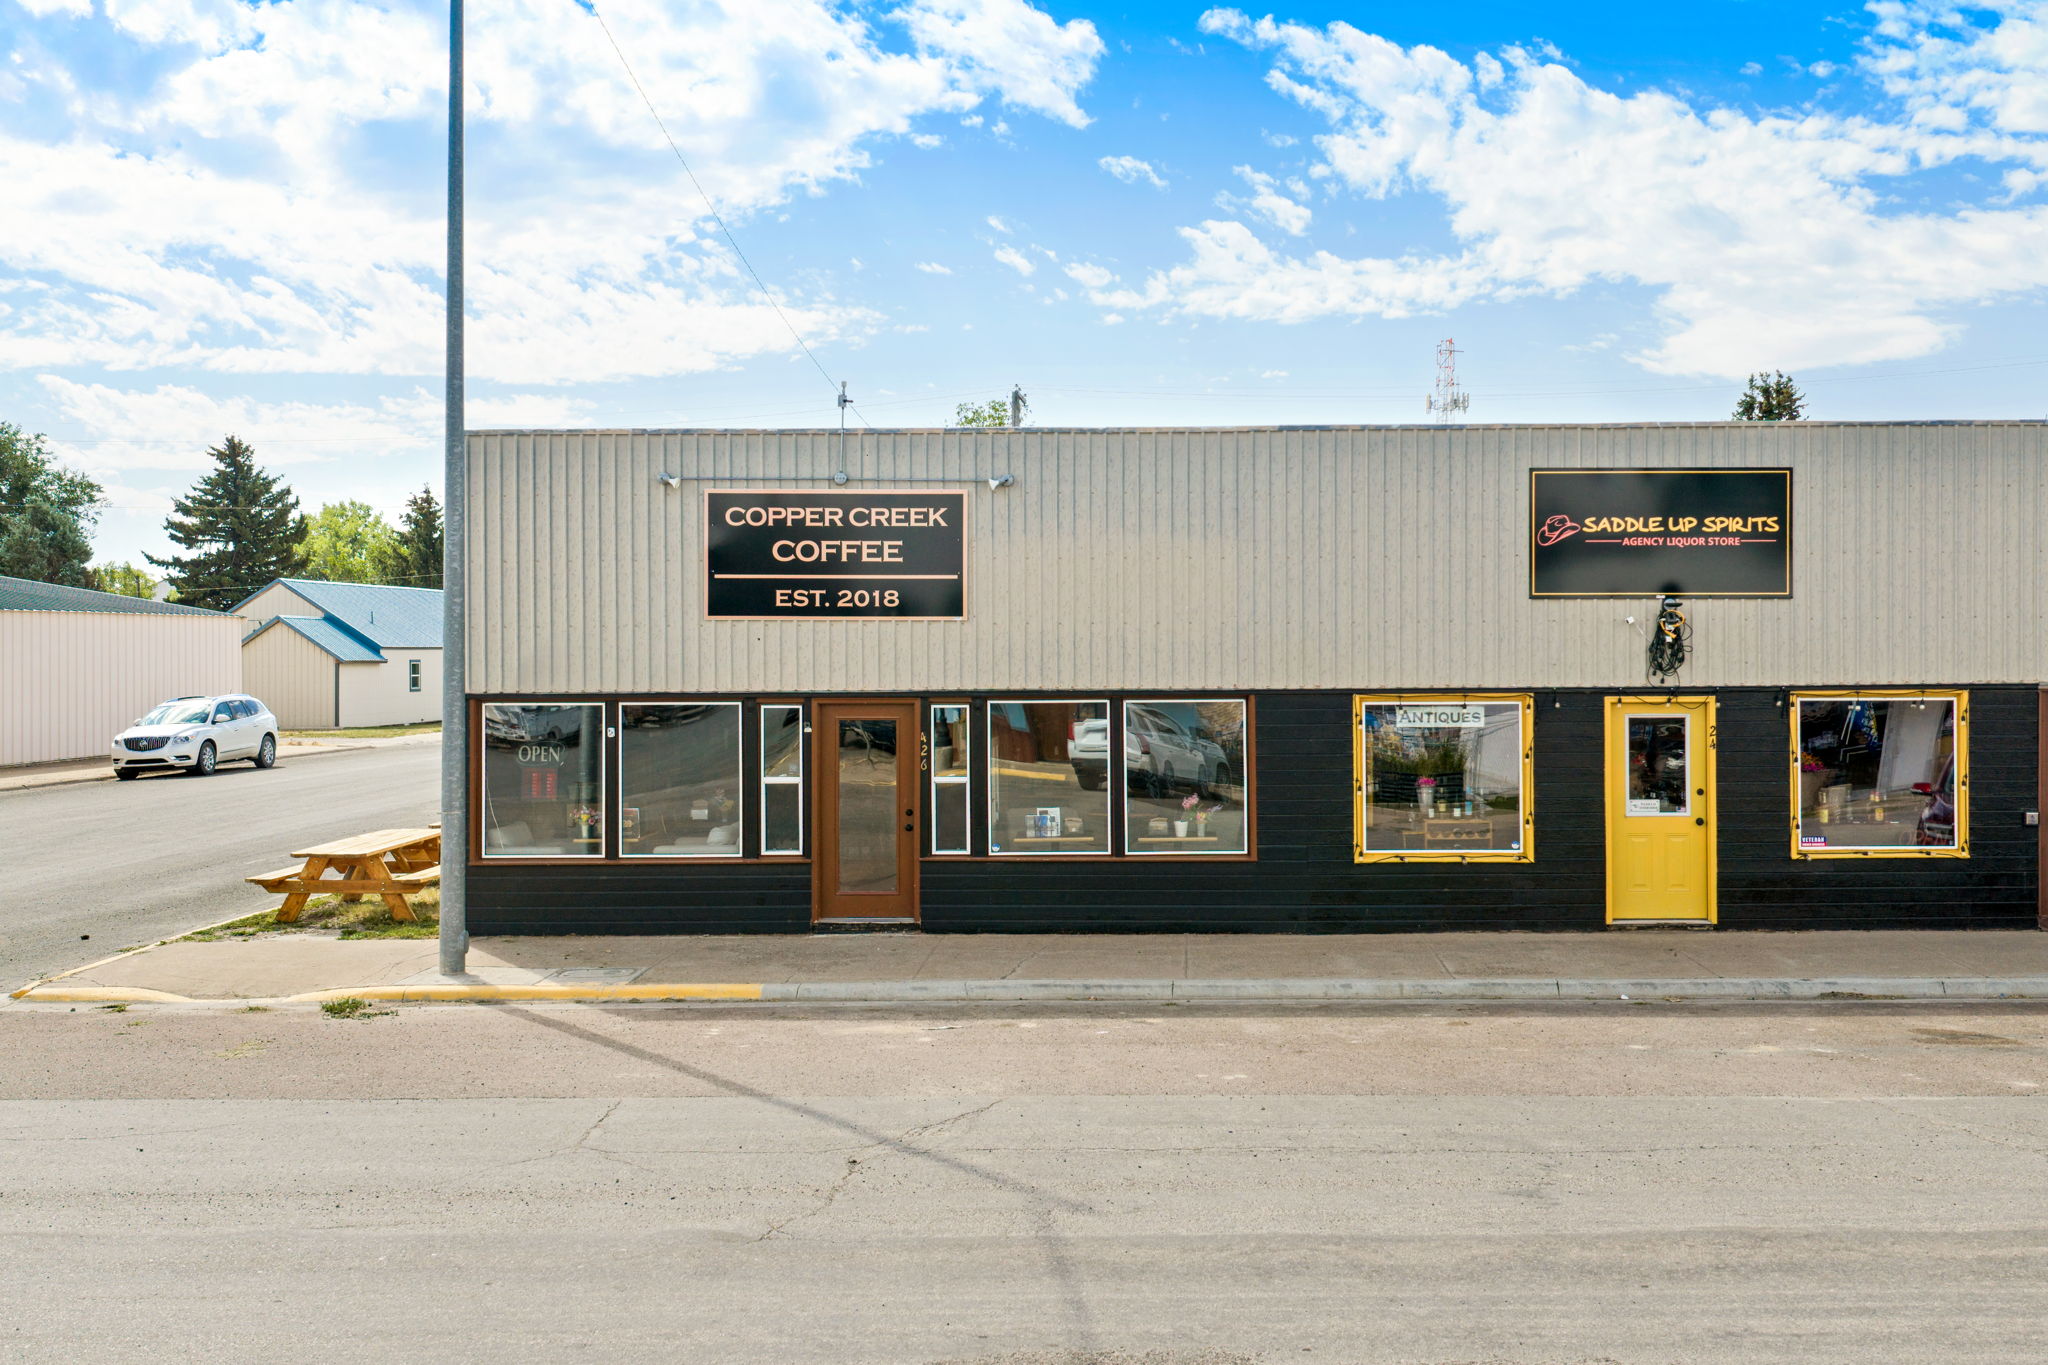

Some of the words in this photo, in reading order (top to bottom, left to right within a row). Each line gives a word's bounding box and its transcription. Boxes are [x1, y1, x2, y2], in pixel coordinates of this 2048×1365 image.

[724, 506, 843, 527] COPPER
[849, 507, 949, 527] CREEK
[1582, 516, 1664, 533] SADDLE
[1669, 516, 1698, 532] UP
[1701, 515, 1780, 533] SPIRITS
[771, 539, 904, 563] COFFEE
[1622, 537, 1664, 546] AGENCY
[1666, 537, 1706, 548] LIQUOR
[1707, 537, 1741, 546] STORE
[775, 589, 831, 608] EST.
[837, 589, 900, 608] 2018
[1398, 709, 1481, 724] ANTIQUES
[518, 745, 560, 762] OPEN
[920, 731, 928, 770] 426
